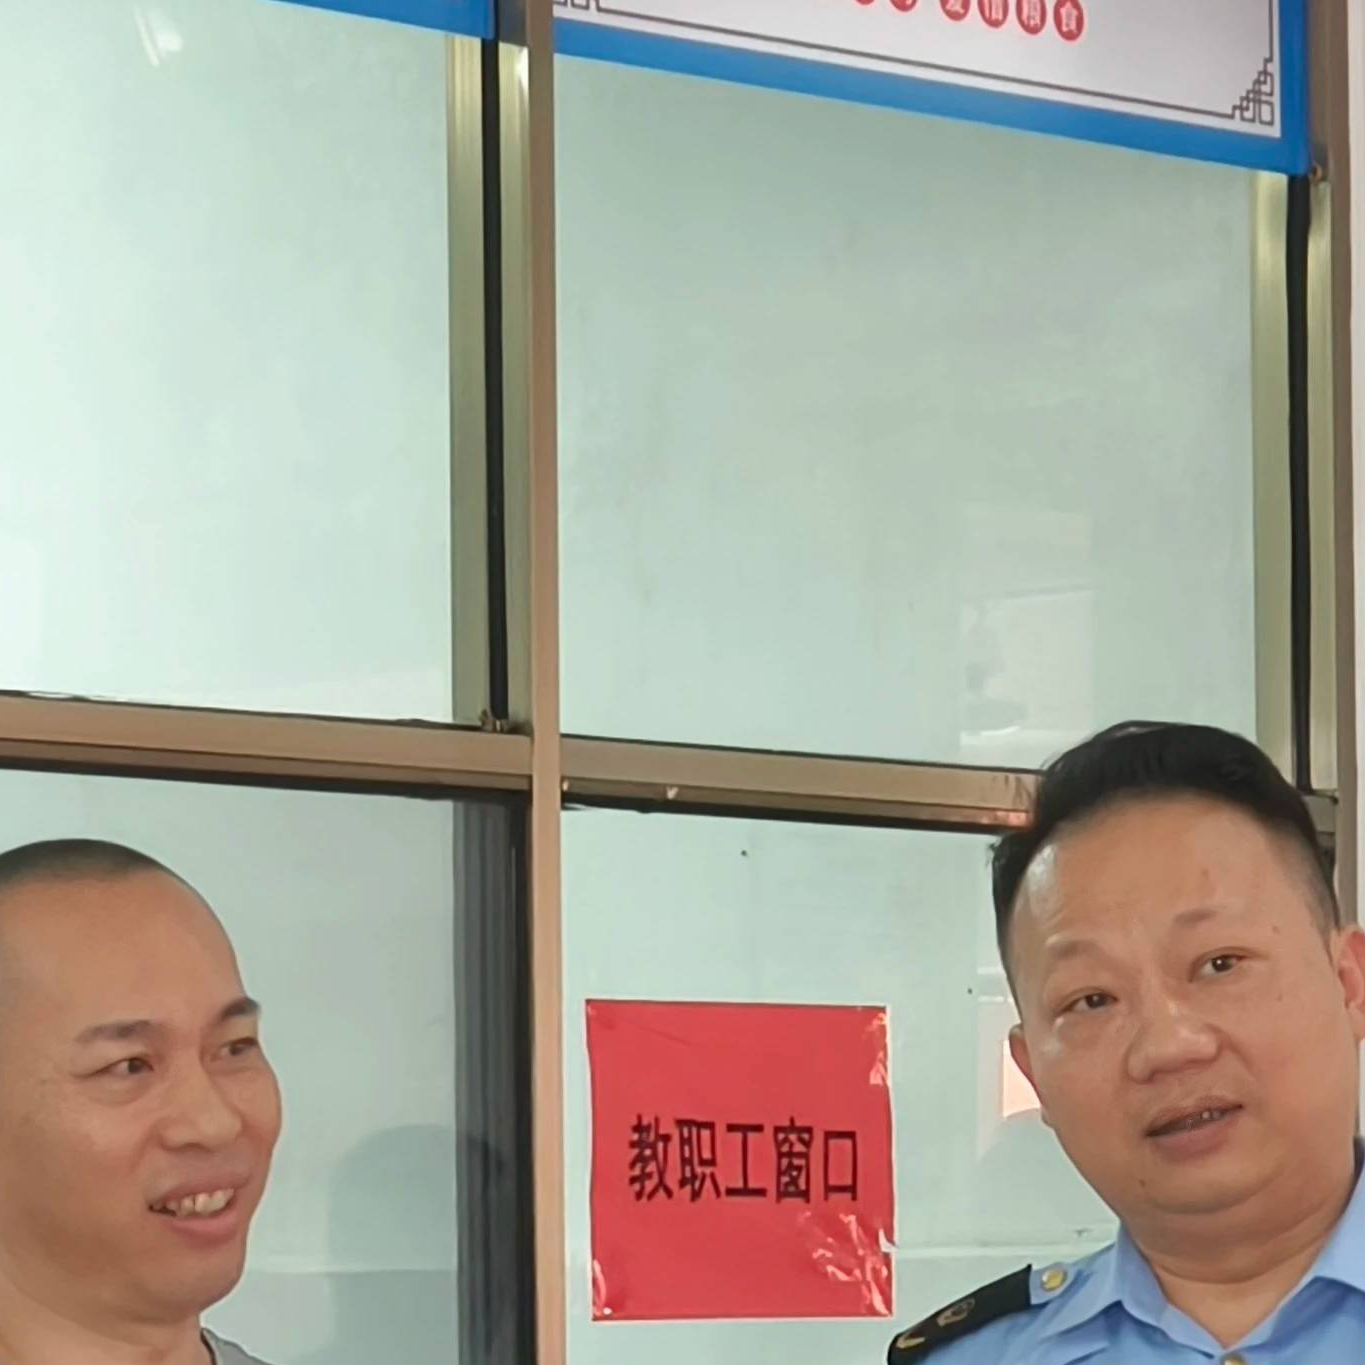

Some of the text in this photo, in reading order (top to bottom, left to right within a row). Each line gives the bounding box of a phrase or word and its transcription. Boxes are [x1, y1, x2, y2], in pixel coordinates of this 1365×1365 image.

[629, 1113, 858, 1203] 教职工窗口
